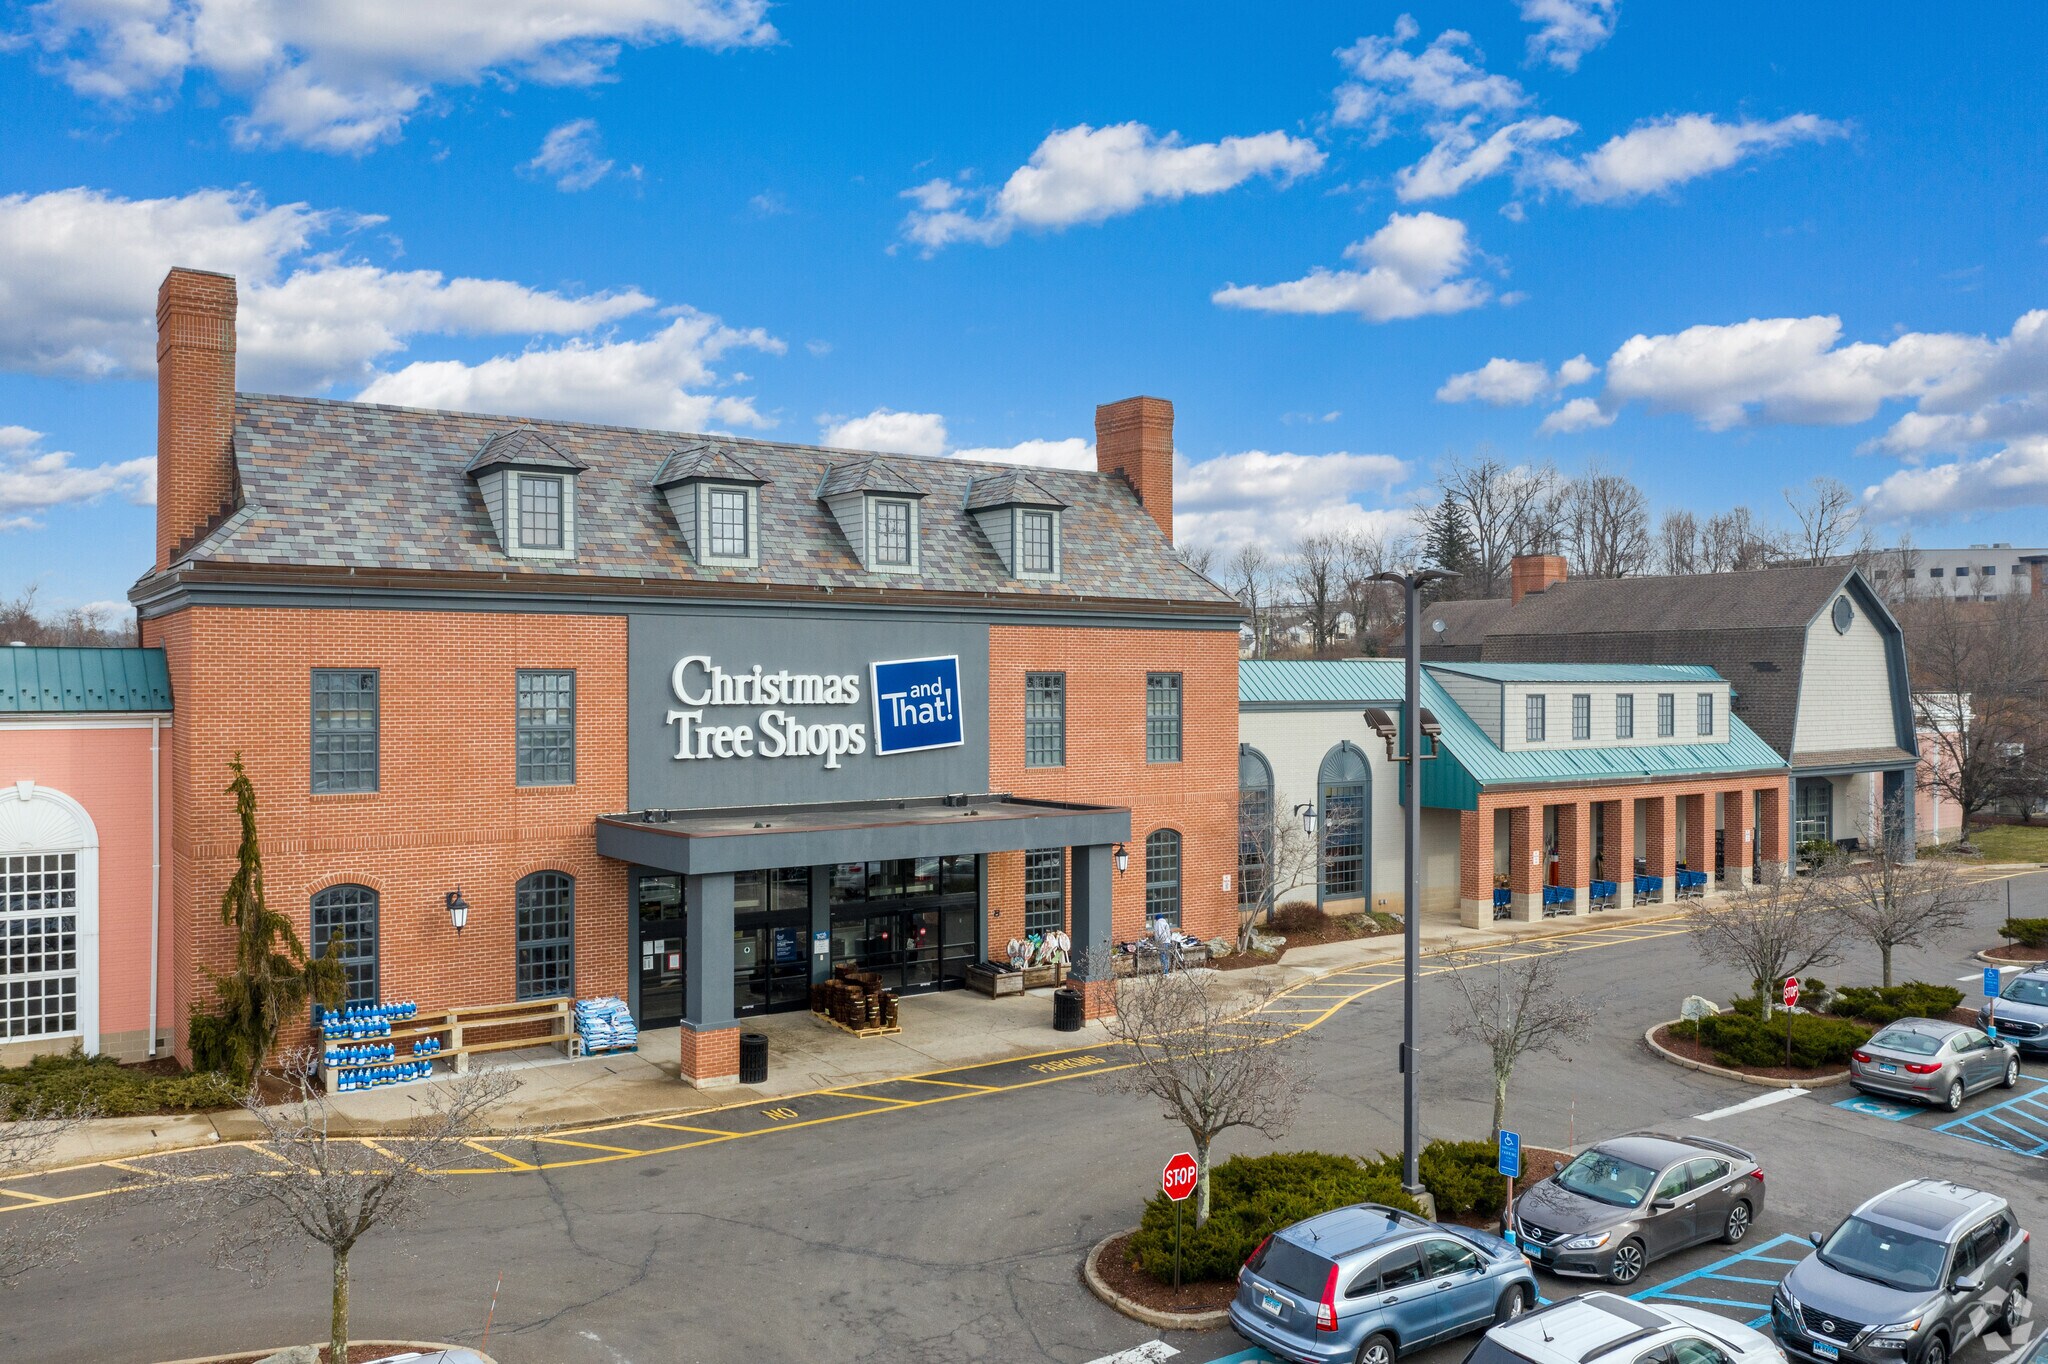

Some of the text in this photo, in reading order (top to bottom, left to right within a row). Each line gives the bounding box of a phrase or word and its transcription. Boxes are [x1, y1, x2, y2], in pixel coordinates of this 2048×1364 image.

[671, 655, 860, 706] Christmas
[910, 676, 942, 698] and
[881, 688, 953, 727] That!
[666, 709, 866, 769] Tree Shops
[1785, 985, 1798, 999] STOP
[1028, 1055, 1106, 1074] PARKING
[762, 1107, 799, 1121] NO
[1165, 1166, 1196, 1188] STOP
